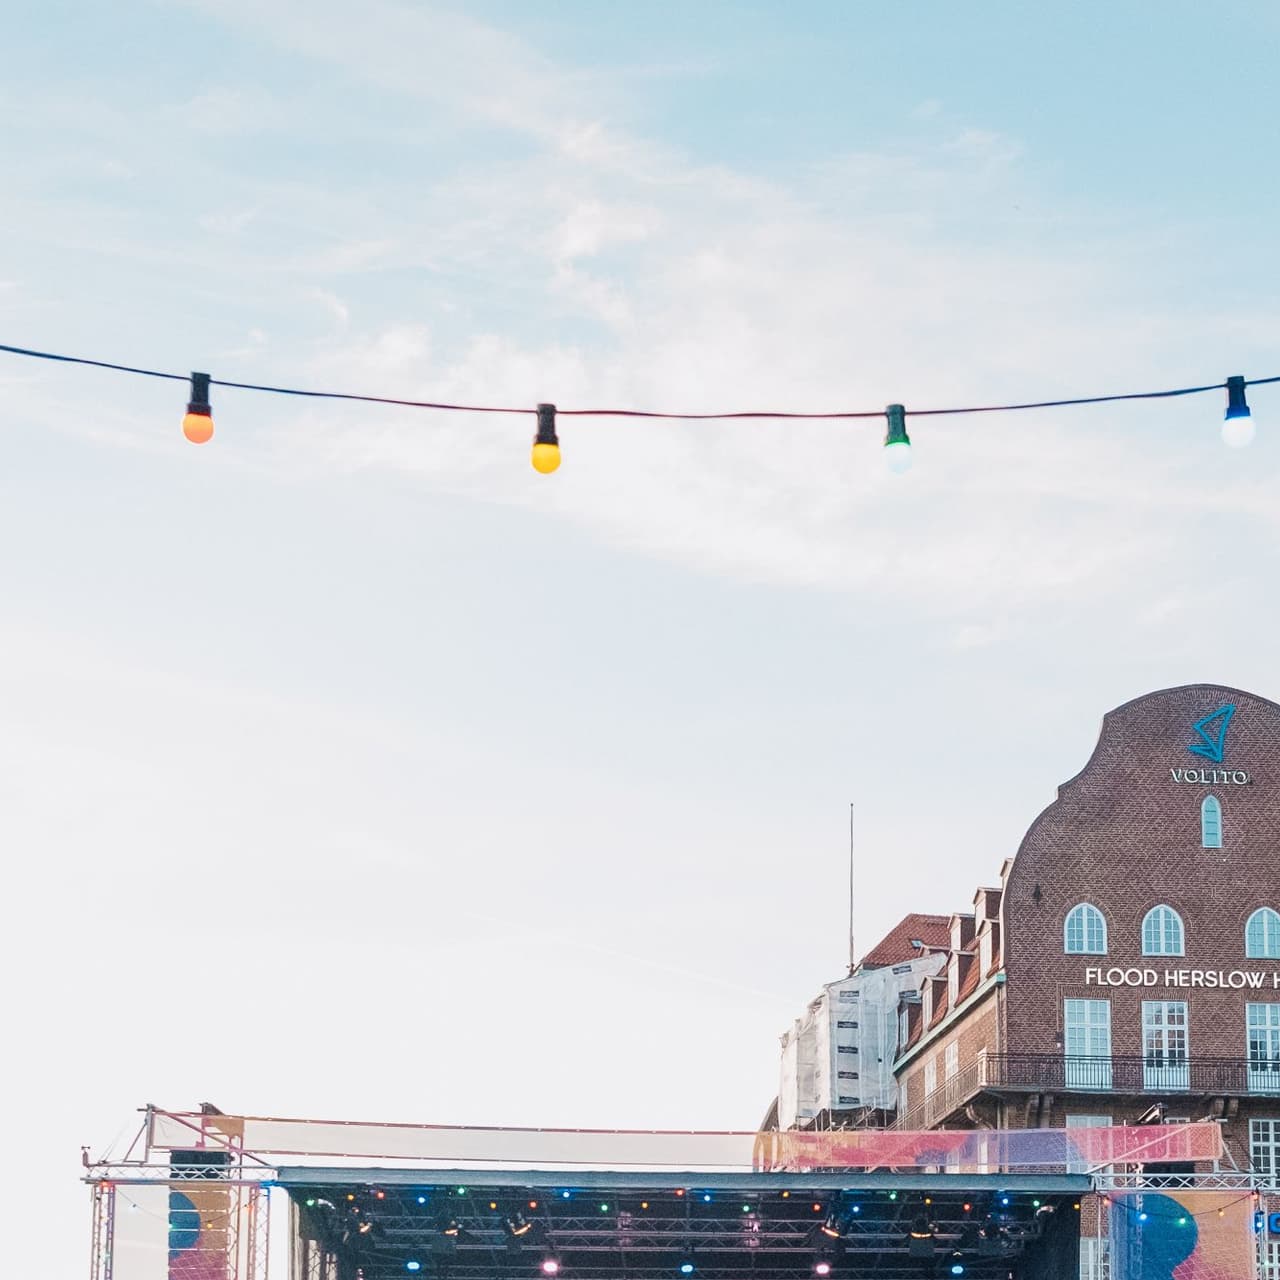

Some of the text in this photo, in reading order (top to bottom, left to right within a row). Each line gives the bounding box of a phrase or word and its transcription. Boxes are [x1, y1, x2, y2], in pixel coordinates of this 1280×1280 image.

[1170, 768, 1248, 785] VOLITO
[1085, 967, 1158, 986] FLOOD
[1164, 970, 1265, 988] HERSLOW
